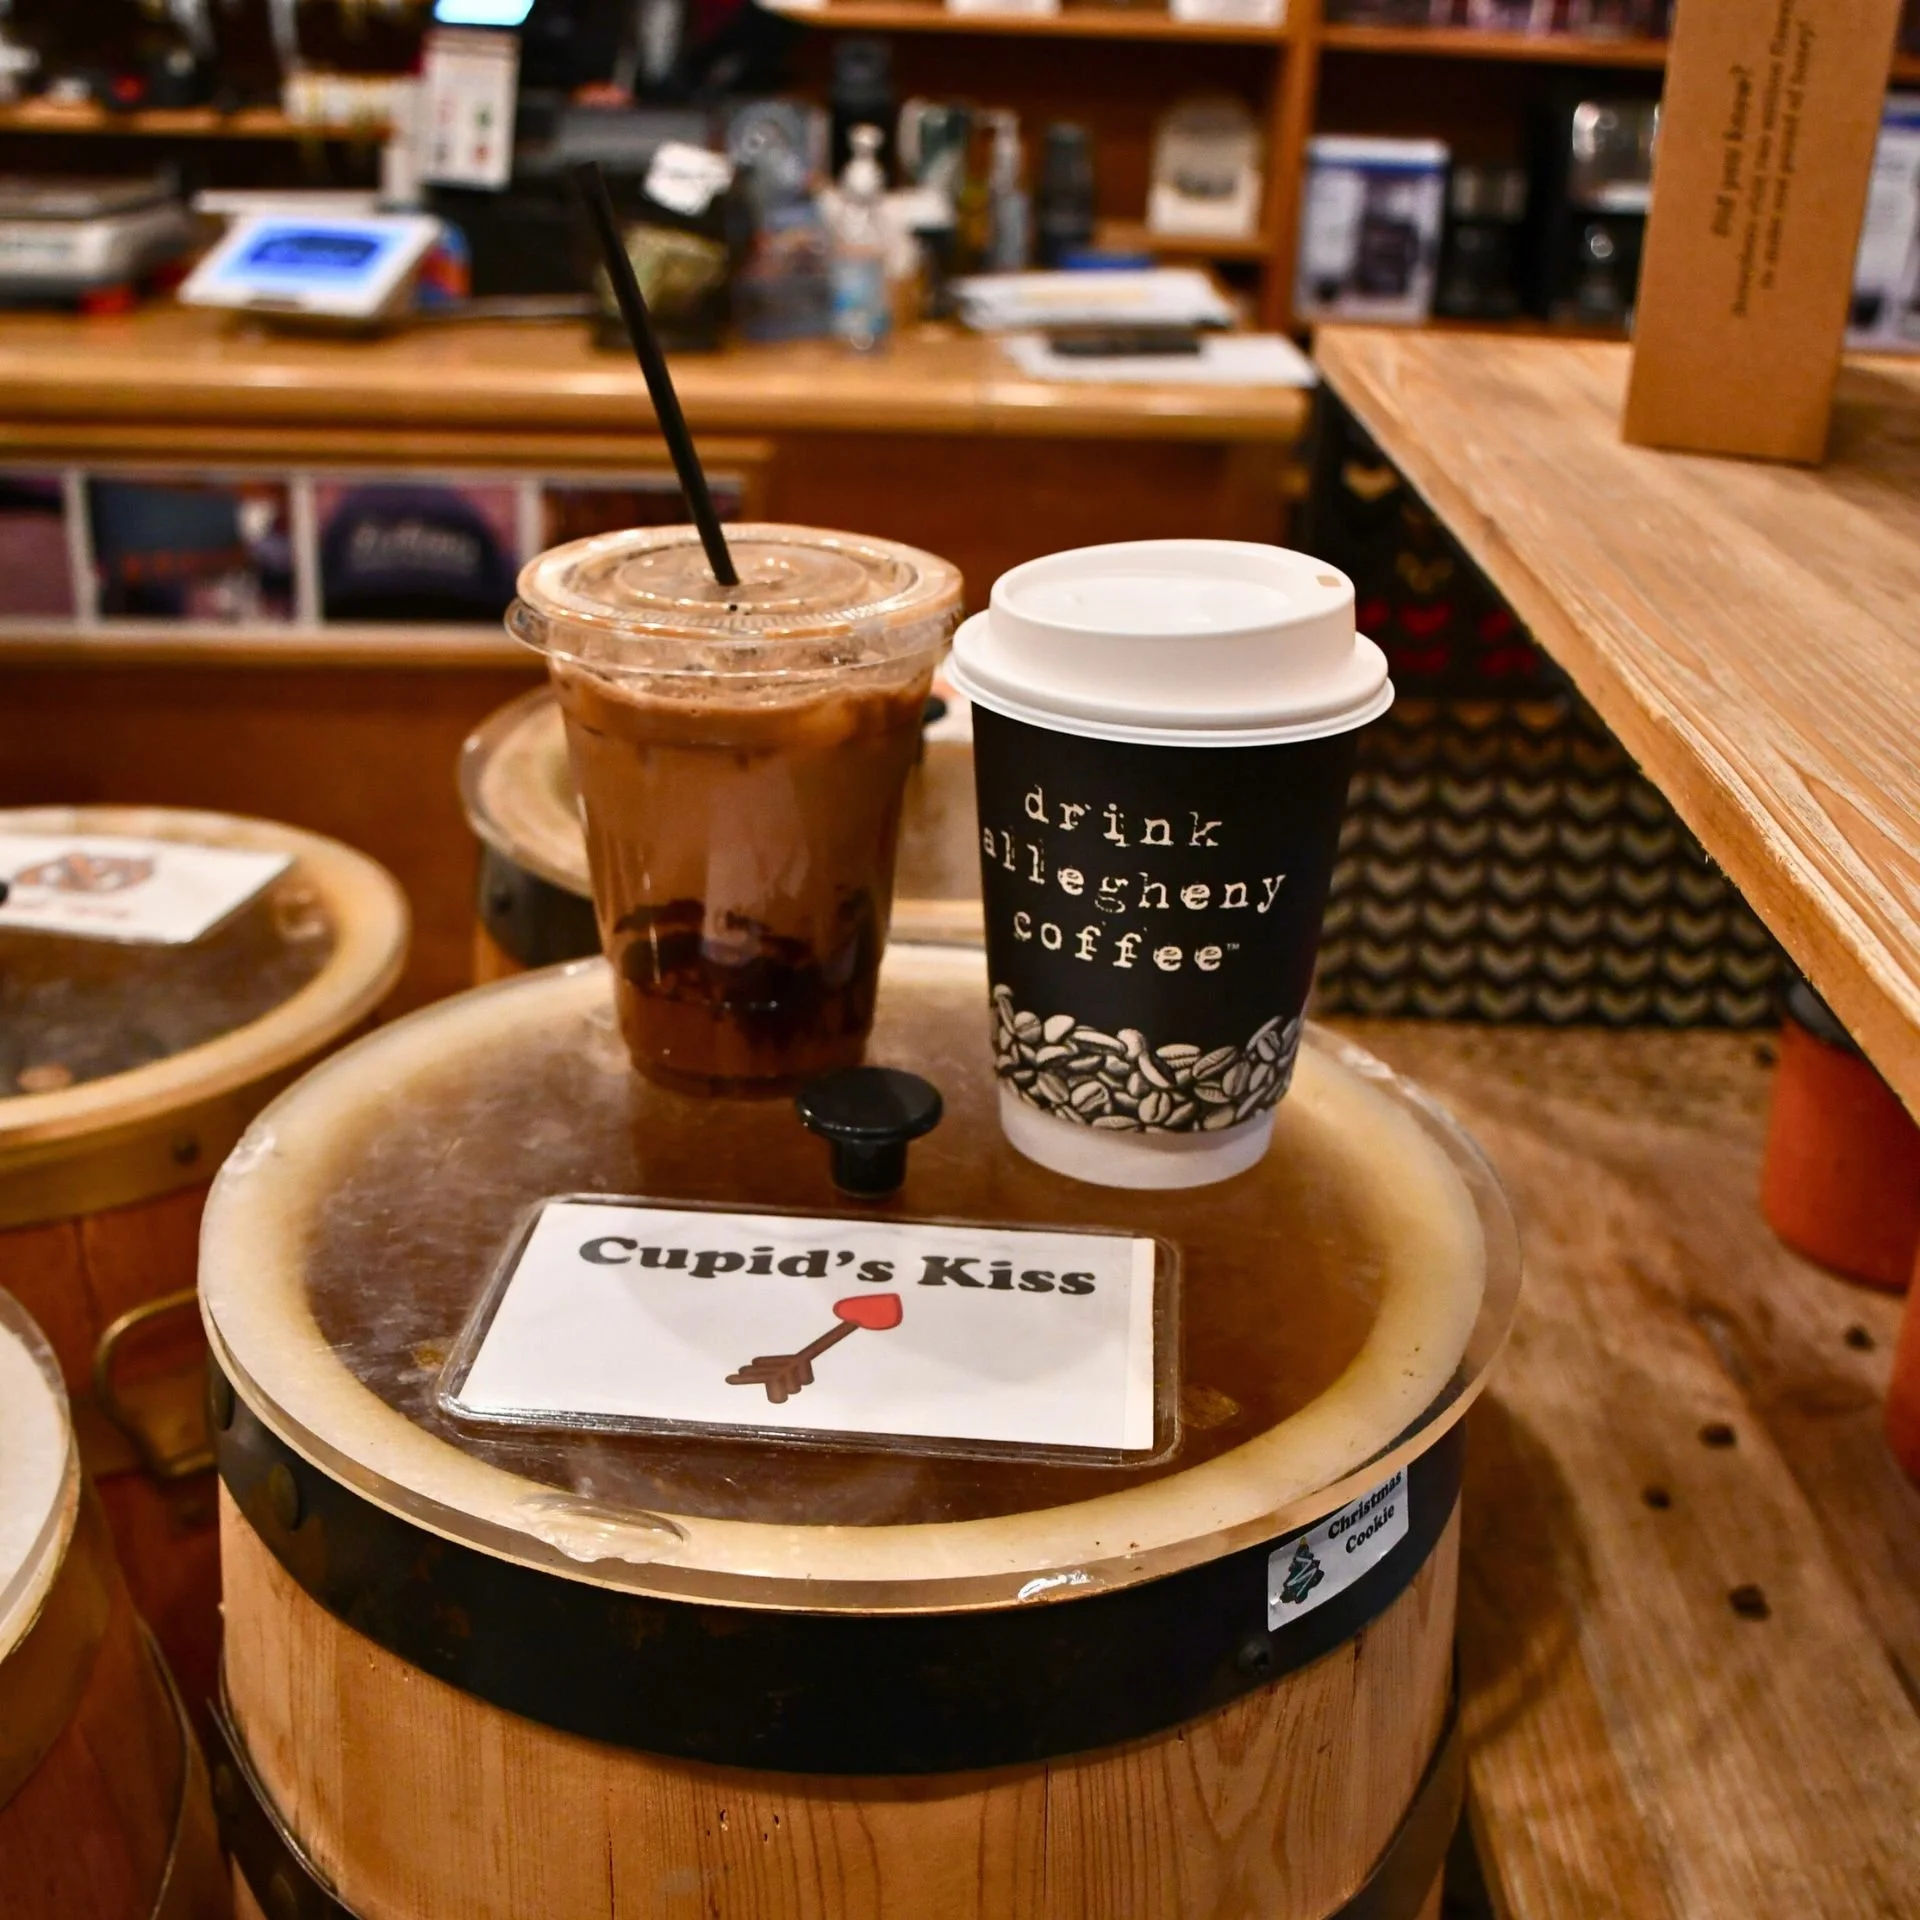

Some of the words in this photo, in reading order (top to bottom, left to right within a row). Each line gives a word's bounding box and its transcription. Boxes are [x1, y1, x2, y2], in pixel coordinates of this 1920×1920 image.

[1025, 784, 1222, 847] drink
[984, 826, 1286, 913] allegheny
[579, 1236, 895, 1282] Cupid's
[917, 1255, 1096, 1295] Kiss
[1328, 1471, 1402, 1539] Christmas
[1346, 1504, 1395, 1553] Cookie
